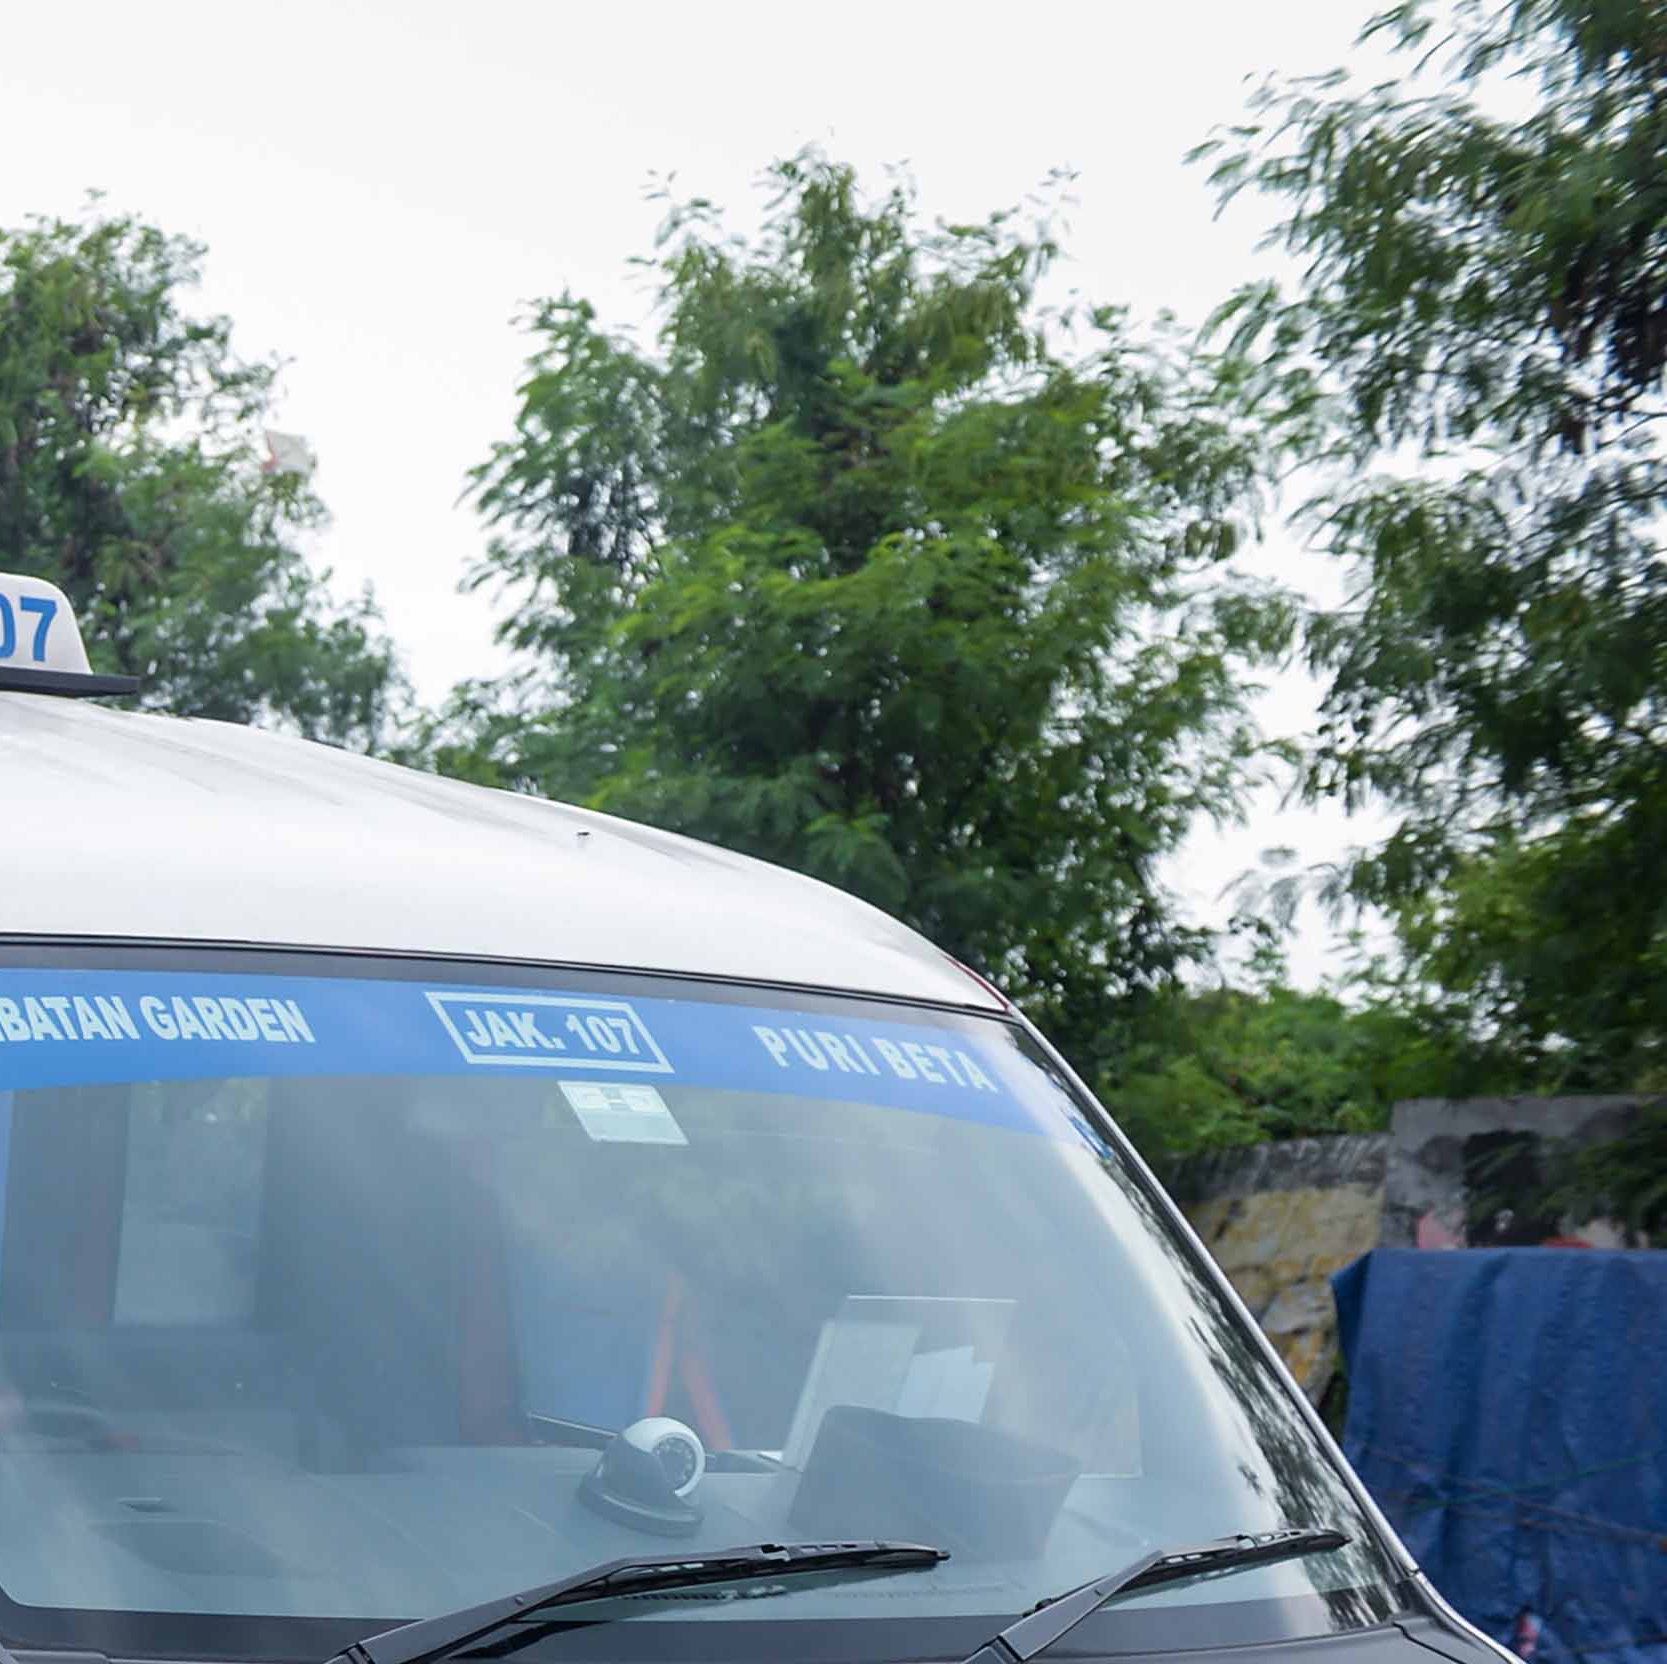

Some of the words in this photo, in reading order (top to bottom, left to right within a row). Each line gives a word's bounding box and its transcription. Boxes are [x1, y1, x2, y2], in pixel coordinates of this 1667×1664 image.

[139, 995, 316, 1044] GARDEN
[463, 1008, 566, 1051] JAK.
[565, 1014, 641, 1056] 107
[751, 1025, 880, 1076] PURI
[877, 1036, 999, 1093] BETA
